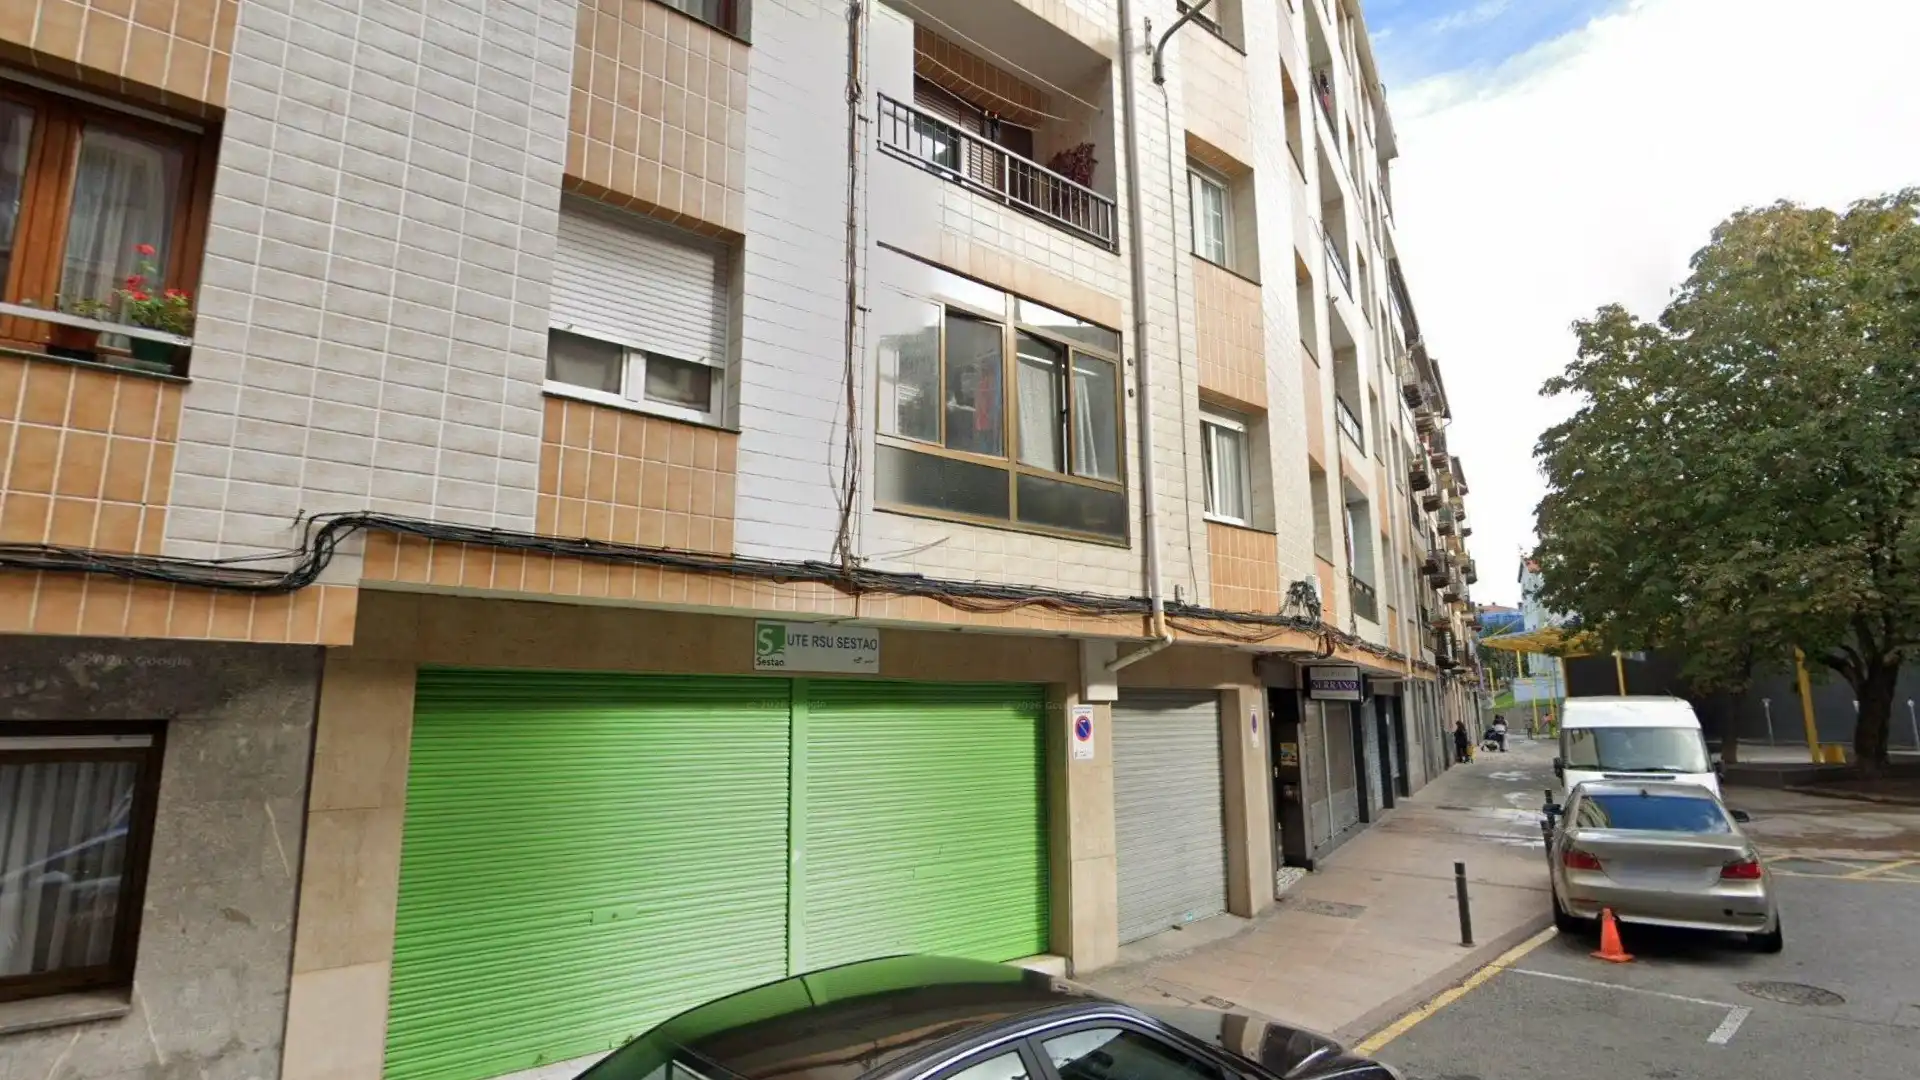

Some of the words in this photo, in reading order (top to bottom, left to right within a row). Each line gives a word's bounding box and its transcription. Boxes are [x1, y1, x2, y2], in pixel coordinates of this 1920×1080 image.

[787, 633, 809, 647] UTE
[811, 635, 834, 649] RSU
[836, 636, 878, 651] SESTAO
[756, 656, 785, 667] Sestao
